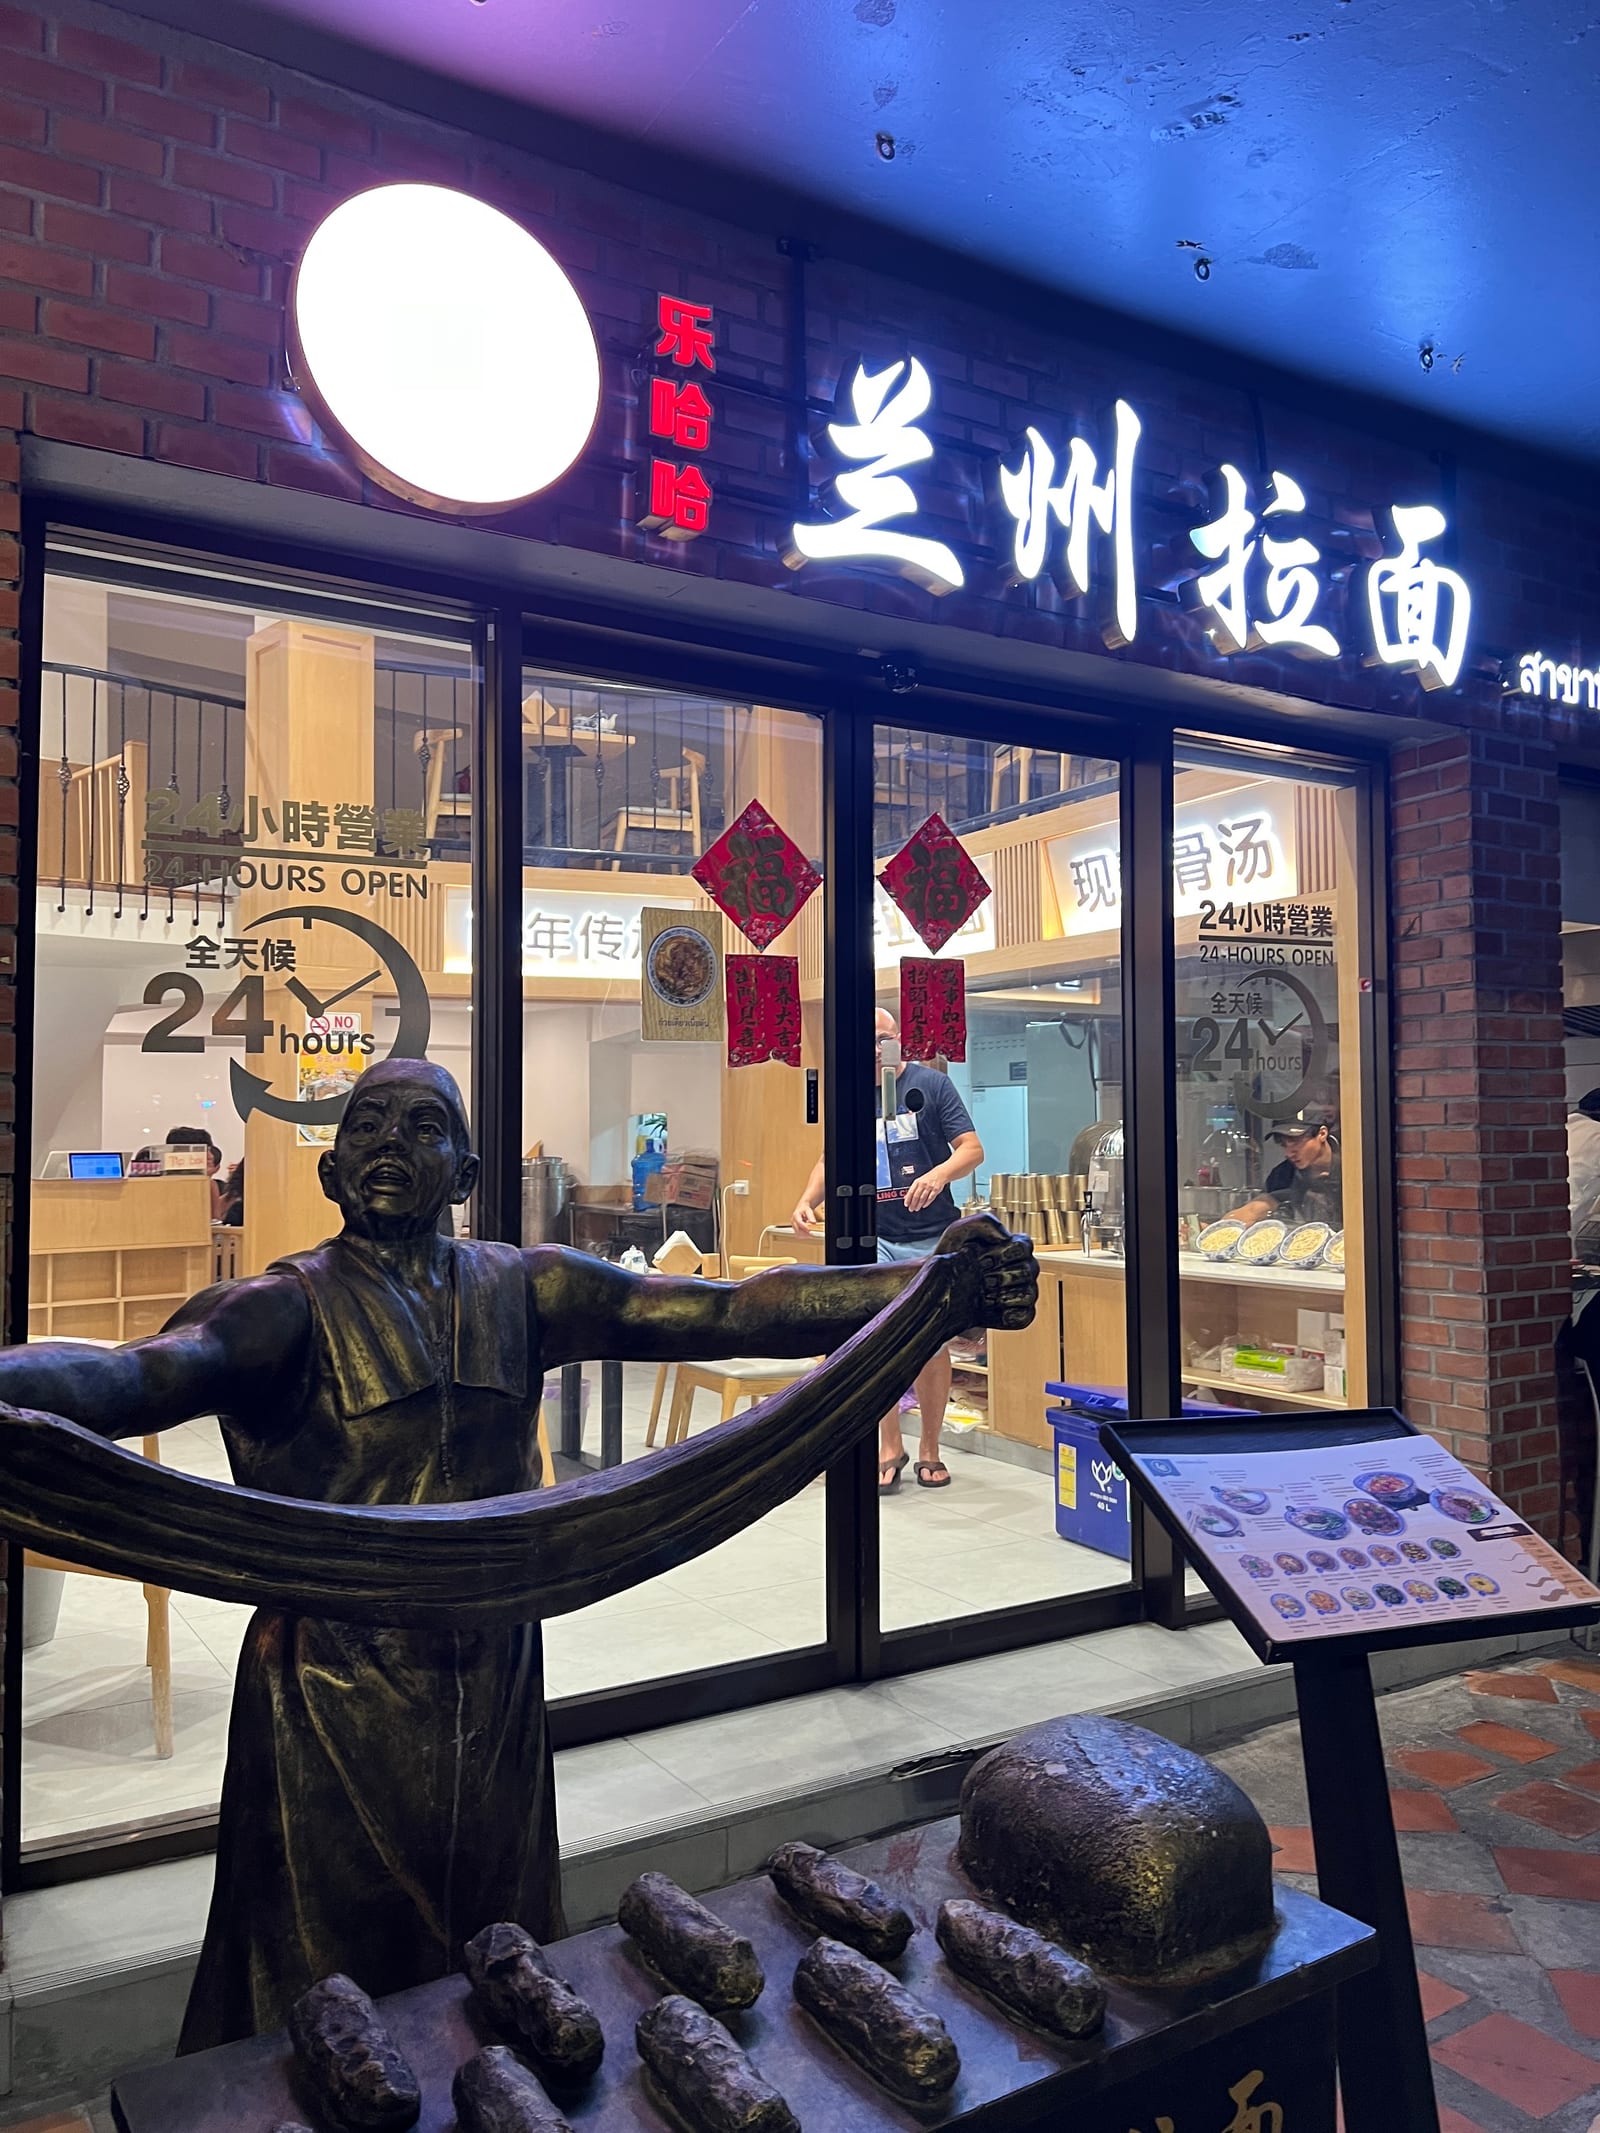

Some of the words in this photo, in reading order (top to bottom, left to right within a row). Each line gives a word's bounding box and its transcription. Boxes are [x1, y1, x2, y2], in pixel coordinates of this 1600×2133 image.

[652, 294, 714, 531] 乐哈哈
[793, 356, 1471, 686] 兰州拉面
[1520, 651, 1600, 710] สาขา
[144, 789, 427, 856] 24小時營業
[143, 854, 326, 893] 24-HOURS
[341, 868, 428, 899] OPEN
[720, 832, 796, 918] 福
[903, 843, 968, 923] 福
[1070, 818, 1272, 912] 现骨汤
[1200, 900, 1333, 938] 24小時營業
[185, 935, 297, 973] 全天候
[1200, 944, 1285, 966] 24-HOURS
[1292, 949, 1333, 967] OPEN
[141, 971, 274, 1053] 24
[280, 1024, 376, 1055] hours
[334, 1015, 354, 1029] NO
[1211, 992, 1263, 1015] 全天候
[1192, 1016, 1254, 1071] 24
[1256, 1050, 1302, 1071] hours
